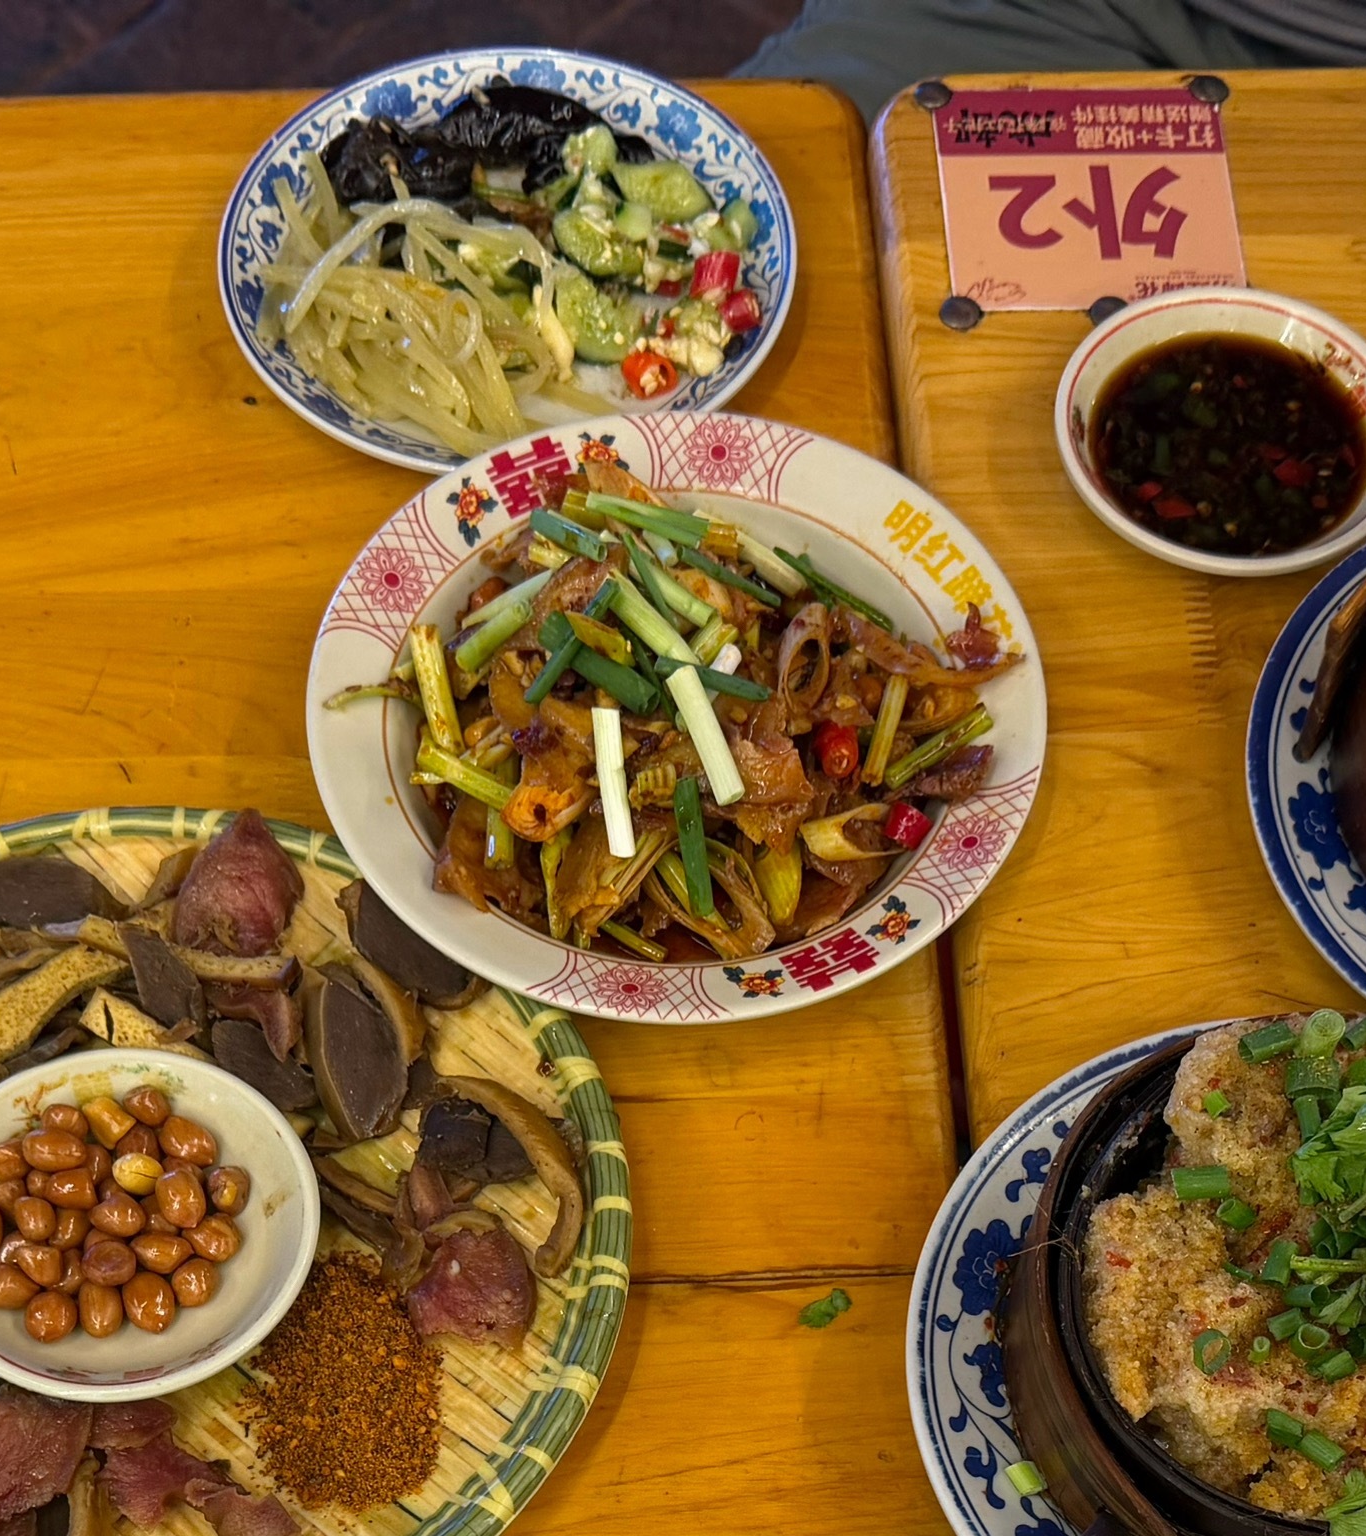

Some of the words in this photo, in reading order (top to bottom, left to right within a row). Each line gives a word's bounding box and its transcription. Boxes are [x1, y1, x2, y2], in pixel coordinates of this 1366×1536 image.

[1075, 125, 1217, 149] 打卡+收藏
[988, 165, 1188, 260] 外2
